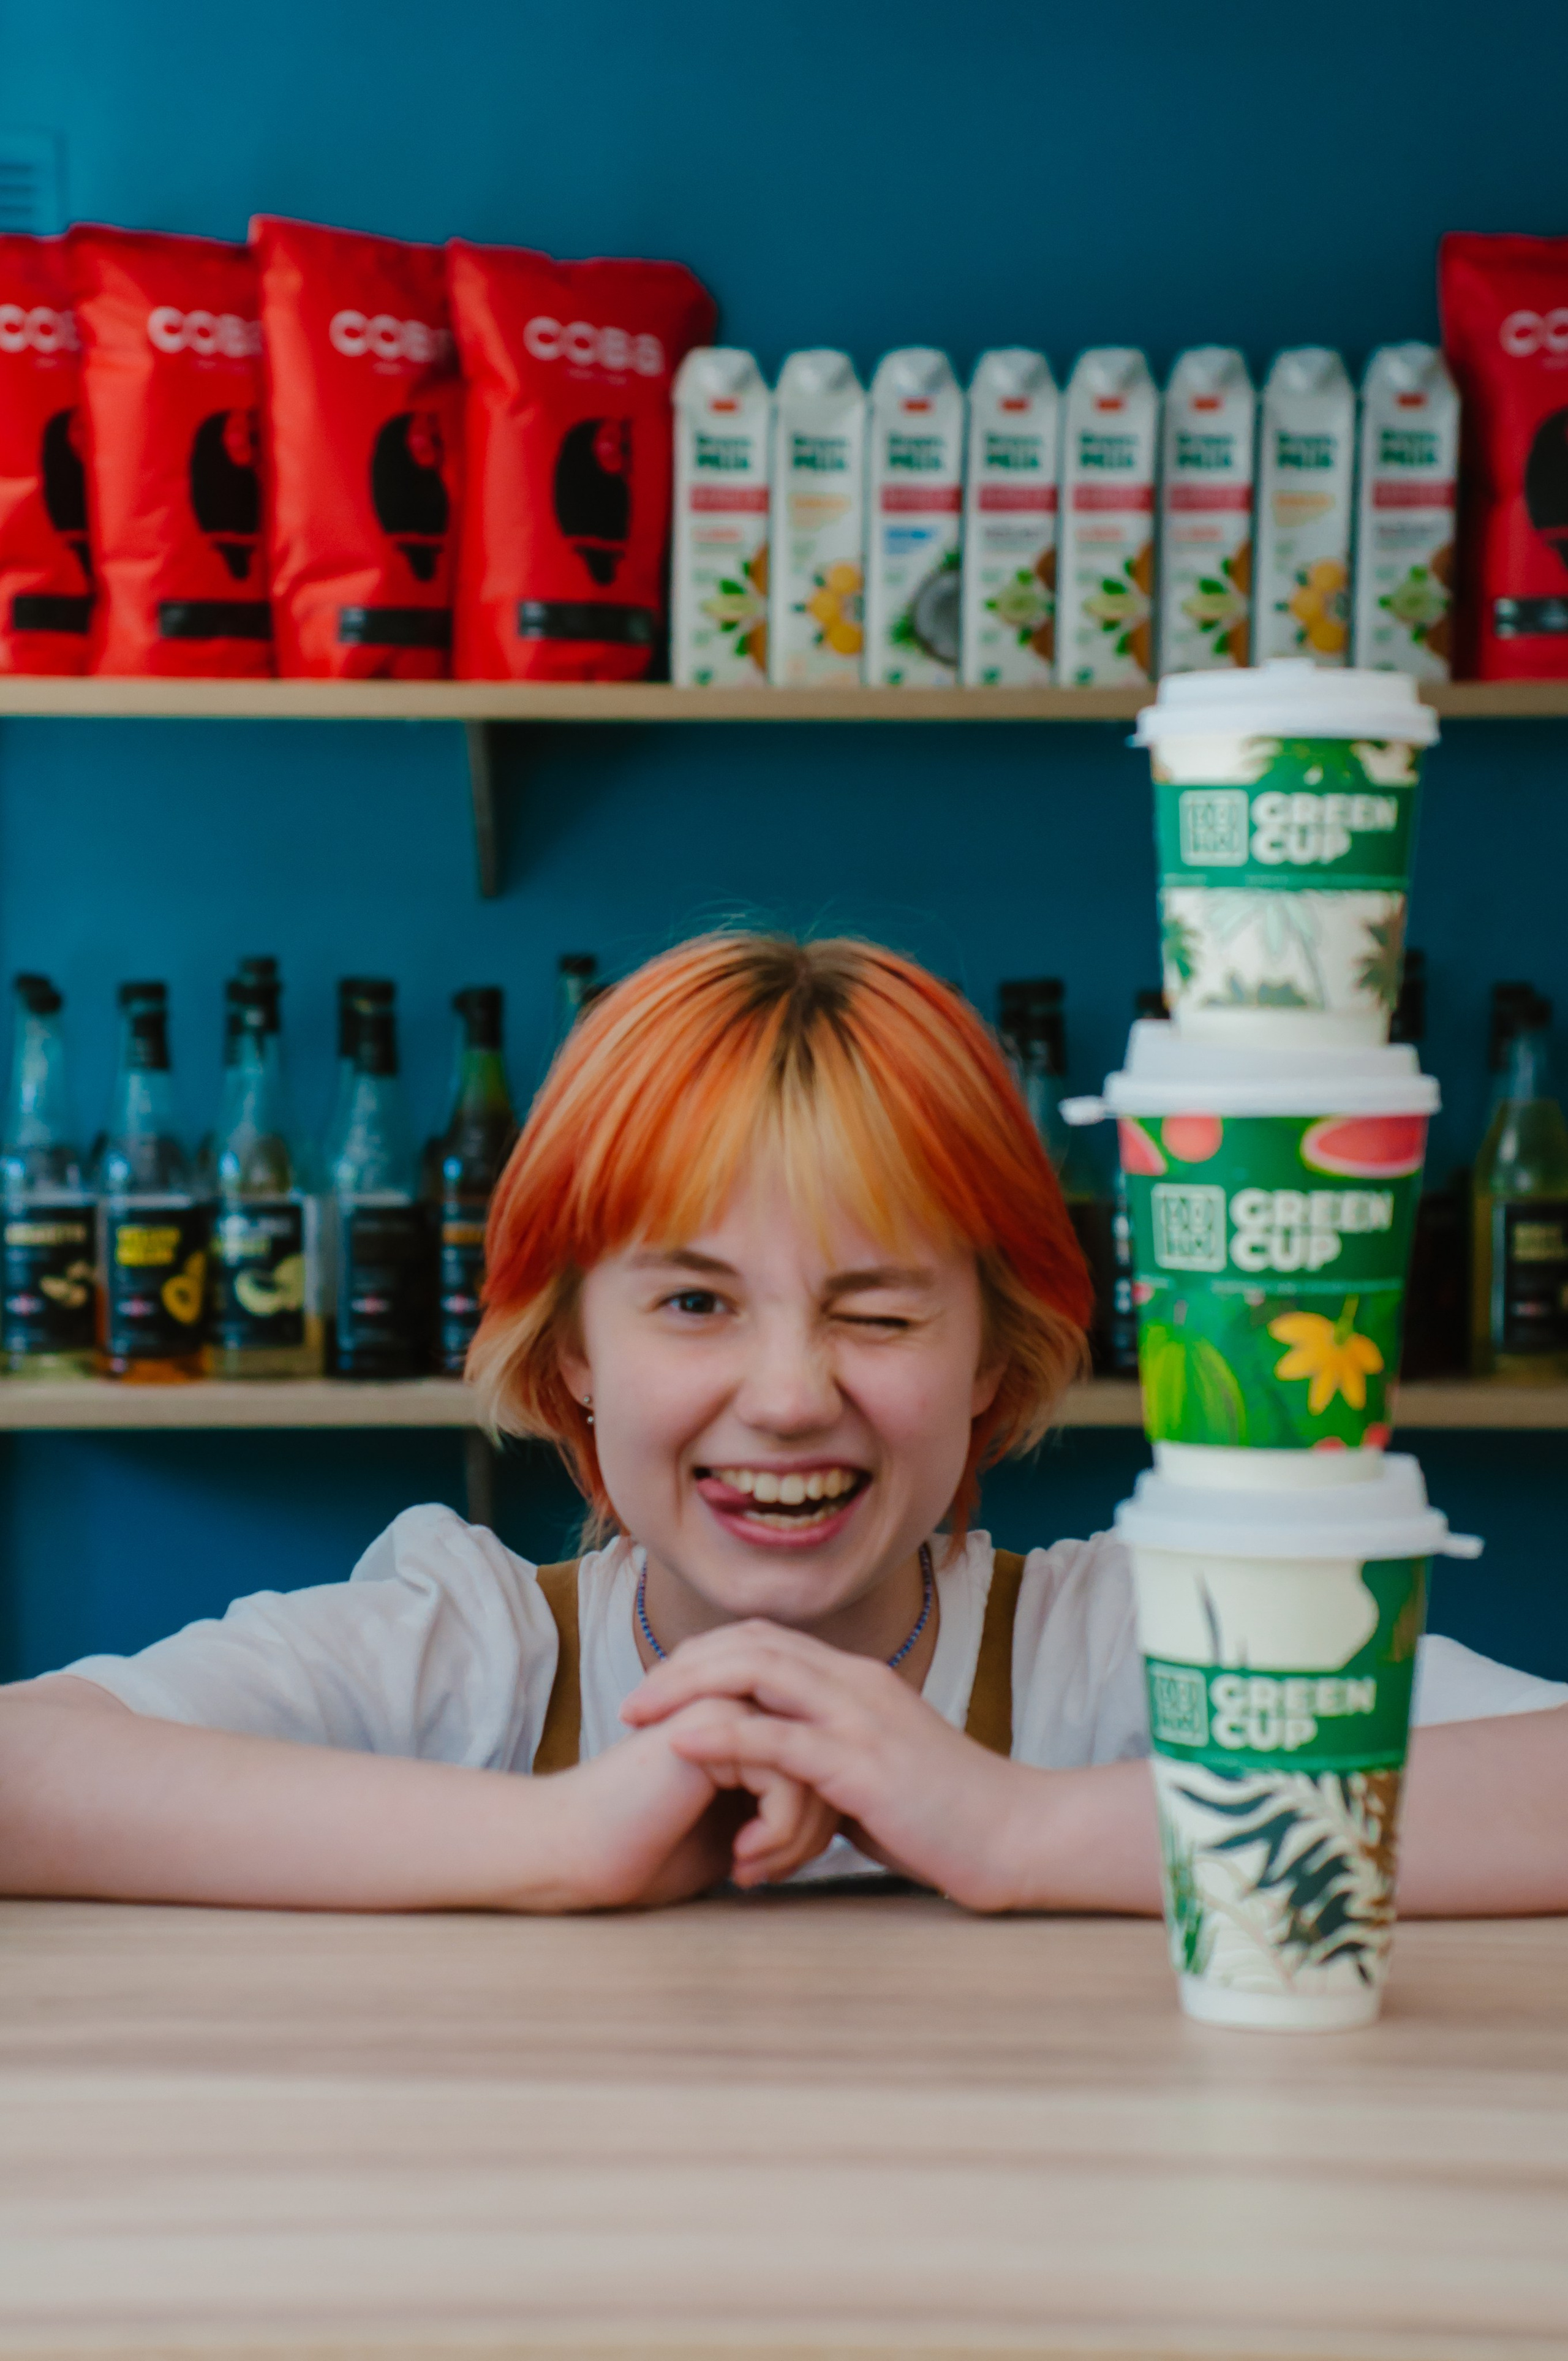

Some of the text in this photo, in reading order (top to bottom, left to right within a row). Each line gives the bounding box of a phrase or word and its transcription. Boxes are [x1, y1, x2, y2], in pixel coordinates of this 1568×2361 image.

[1252, 791, 1398, 831] GREEN
[1251, 825, 1352, 865] CUP
[1230, 1188, 1393, 1233] GREEN
[1230, 1228, 1341, 1272] CUP
[1210, 1674, 1376, 1717] GREEN
[1210, 1713, 1317, 1751] CUP
